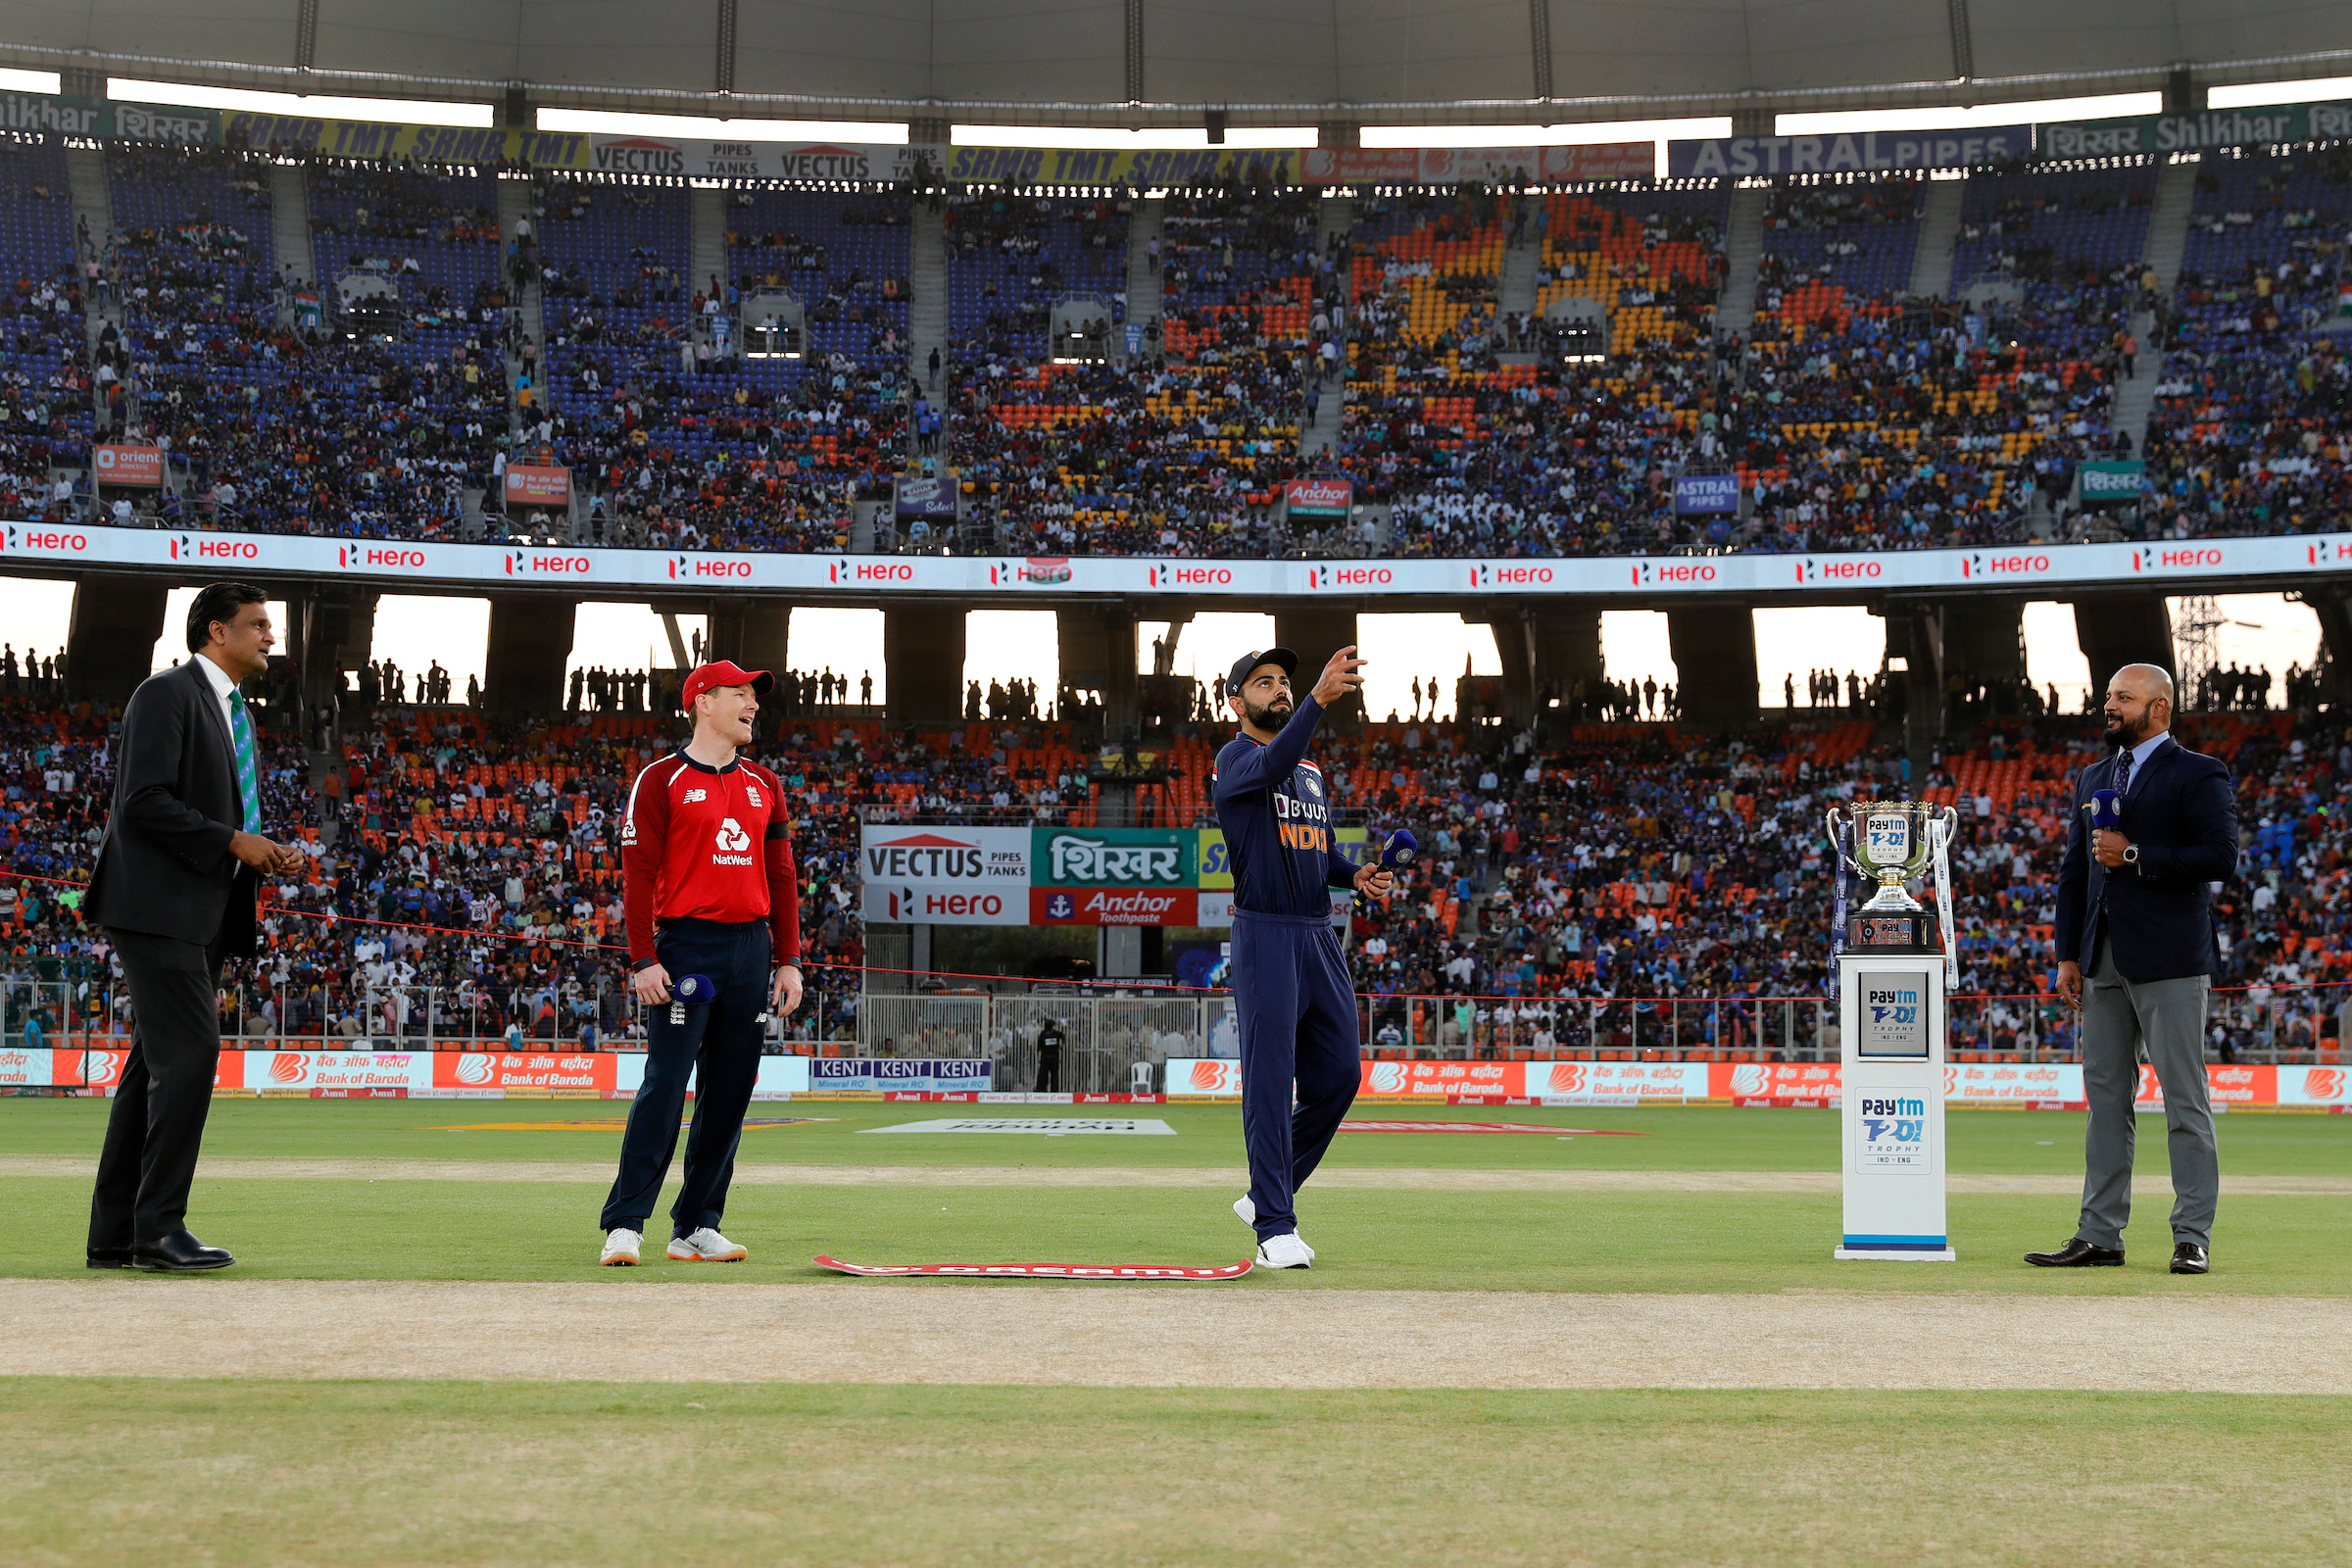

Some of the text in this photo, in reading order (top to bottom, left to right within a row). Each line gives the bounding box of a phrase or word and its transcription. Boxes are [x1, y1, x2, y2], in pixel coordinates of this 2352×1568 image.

[115, 104, 210, 142] शिखर
[2155, 112, 2291, 150] Shikhar
[334, 121, 404, 157] TMT
[411, 127, 586, 166] SRMB TMT
[2044, 125, 2140, 158] शिखर
[712, 143, 753, 157] PIPES
[1691, 132, 2007, 177] ASTRAL PIPES
[595, 147, 684, 174] VECTUS
[707, 161, 759, 175] TANKS
[781, 154, 869, 179] VECTUS
[951, 147, 1120, 183] SRMB TMT
[120, 450, 160, 464] orient
[1677, 479, 1738, 496] ASTRAL
[2082, 470, 2142, 492] शिखर
[1289, 485, 1348, 500] Anchor
[925, 500, 955, 514] Select
[1688, 495, 1725, 507] PIPES
[27, 532, 86, 551] Hero
[199, 541, 258, 559] Hero
[368, 549, 425, 567] Hero
[534, 557, 590, 573] Hero
[1992, 556, 2050, 572] Hero
[2163, 550, 2223, 566] Hero
[697, 562, 752, 577] Hero
[858, 564, 913, 580] Hero
[1177, 568, 1232, 584] Hero
[1338, 568, 1393, 584] Hero
[1497, 567, 1553, 583] Hero
[1659, 565, 1715, 581] Hero
[1825, 562, 1882, 578] Hero
[712, 854, 753, 866] NatWest
[868, 848, 983, 877] VECTUS
[991, 852, 1021, 862] PIPES
[1050, 835, 1181, 880] शिखर
[987, 865, 1026, 876] TANKS
[926, 894, 1002, 915] Hero
[1084, 891, 1177, 912] Anchor
[1099, 912, 1161, 924] Toothpaste
[0, 1052, 28, 1067] ड़ौदा
[317, 1053, 338, 1067] बैंक
[501, 1054, 522, 1068] बैंक
[821, 1061, 864, 1076] KENT
[881, 1062, 924, 1077] KENT
[941, 1061, 984, 1077] KENT
[1413, 1062, 1434, 1076] बैंक
[316, 1072, 410, 1085] Bank of Baroda
[501, 1073, 593, 1086] Bank of Baroda
[877, 1080, 909, 1089] Mineral
[937, 1080, 969, 1089] Mineral
[1412, 1081, 1504, 1094] Bank of Baroda
[1592, 1083, 1684, 1095] Bank of Baroda
[1776, 1084, 1807, 1096] Bank
[1808, 1084, 1821, 1096] of
[1964, 1085, 2059, 1097] Bank of Baroda
[942, 1093, 968, 1102] Amul
[1084, 1094, 1109, 1102] Amul
[1130, 1094, 1156, 1102] Amul
[1505, 1096, 1531, 1104] Amul
